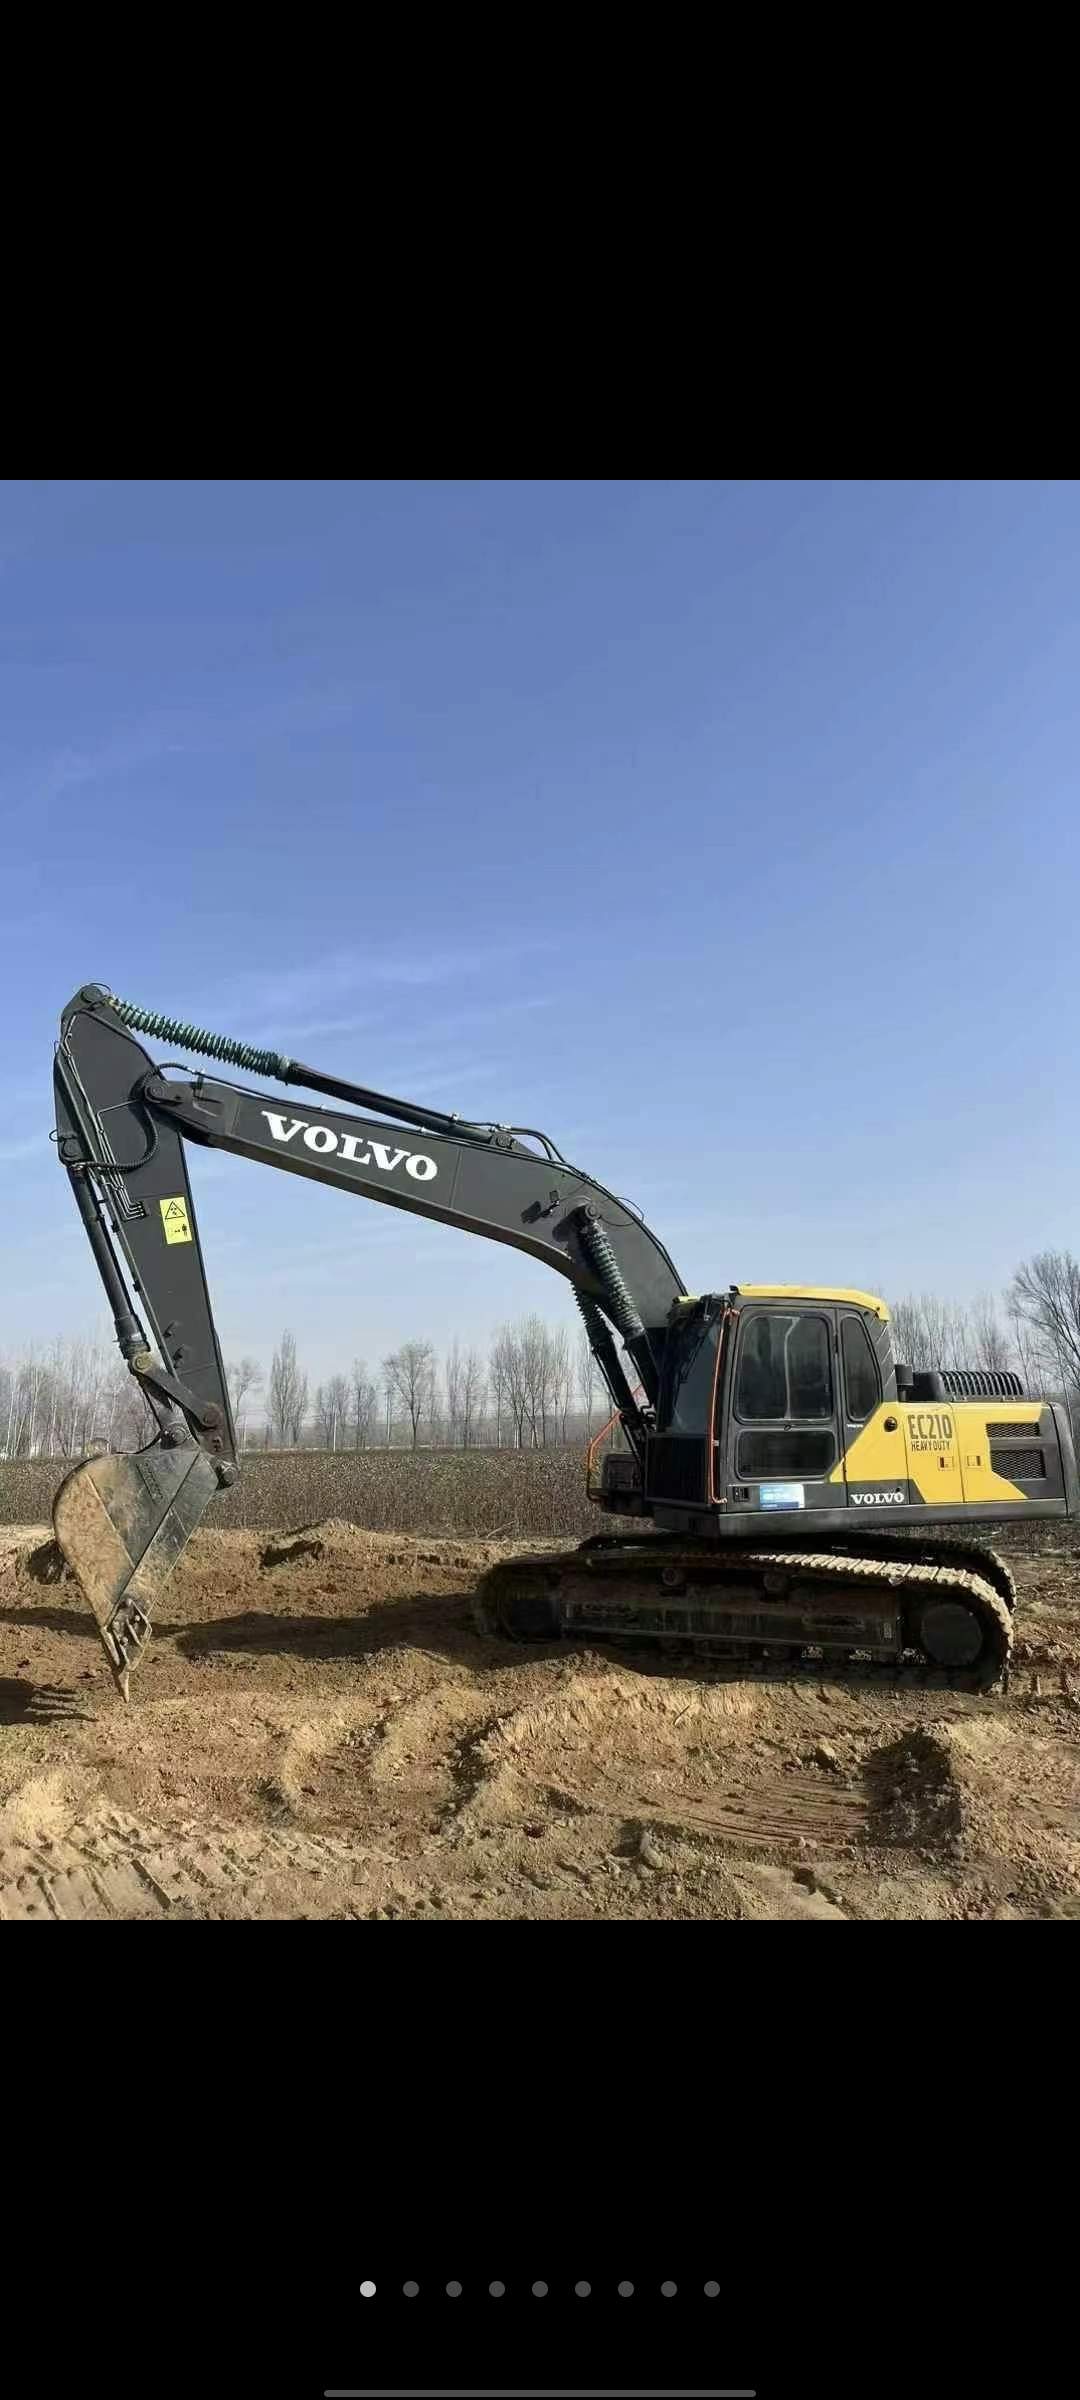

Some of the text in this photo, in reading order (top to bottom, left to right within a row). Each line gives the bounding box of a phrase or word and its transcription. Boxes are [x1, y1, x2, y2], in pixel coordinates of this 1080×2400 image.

[261, 1110, 438, 1181] VOLVO
[907, 1414, 953, 1440] EC210
[911, 1440, 950, 1451] HEAVY DUTY
[850, 1492, 905, 1505] VOLVO
